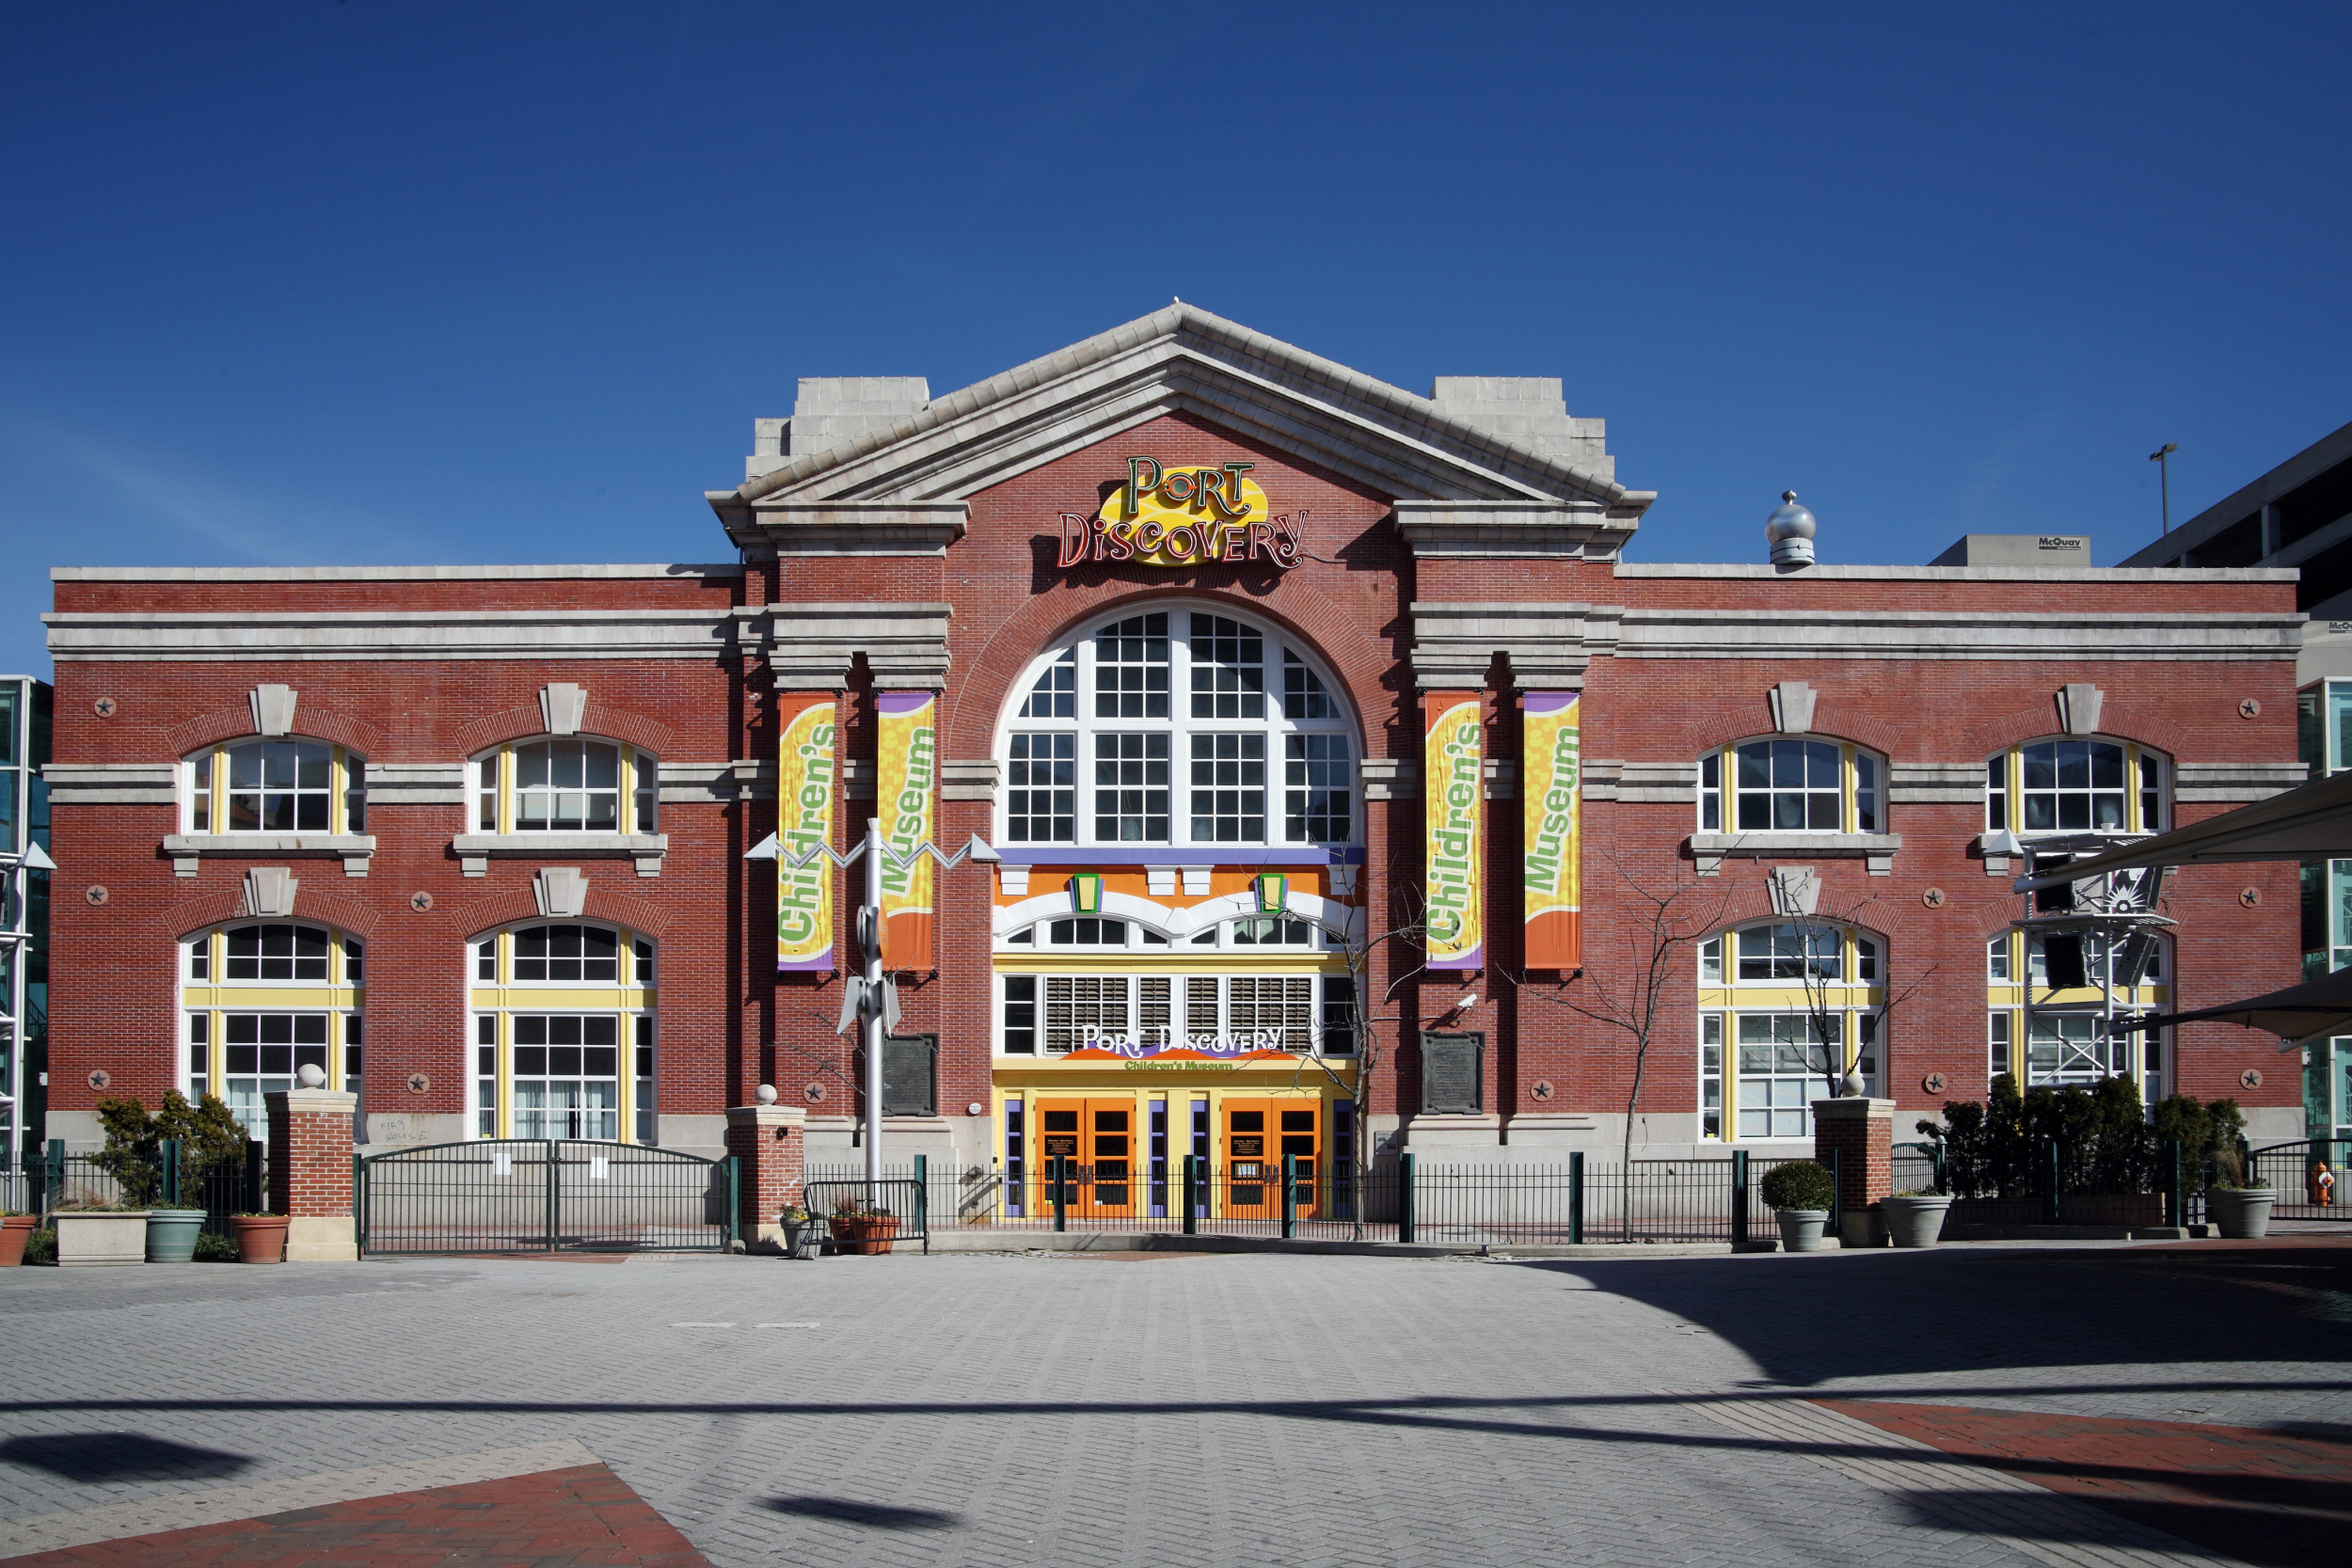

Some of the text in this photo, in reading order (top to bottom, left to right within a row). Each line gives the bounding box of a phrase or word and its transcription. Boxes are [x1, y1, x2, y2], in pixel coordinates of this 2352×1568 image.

[1126, 456, 1255, 515] PORT
[2039, 537, 2080, 546] McQuay
[777, 724, 835, 942] Children's
[1425, 723, 1481, 941] Children's
[1525, 727, 1580, 893] Museum
[1082, 1024, 1282, 1059] PORT DSCOVERY
[1124, 1060, 1233, 1070] Children's Museum
